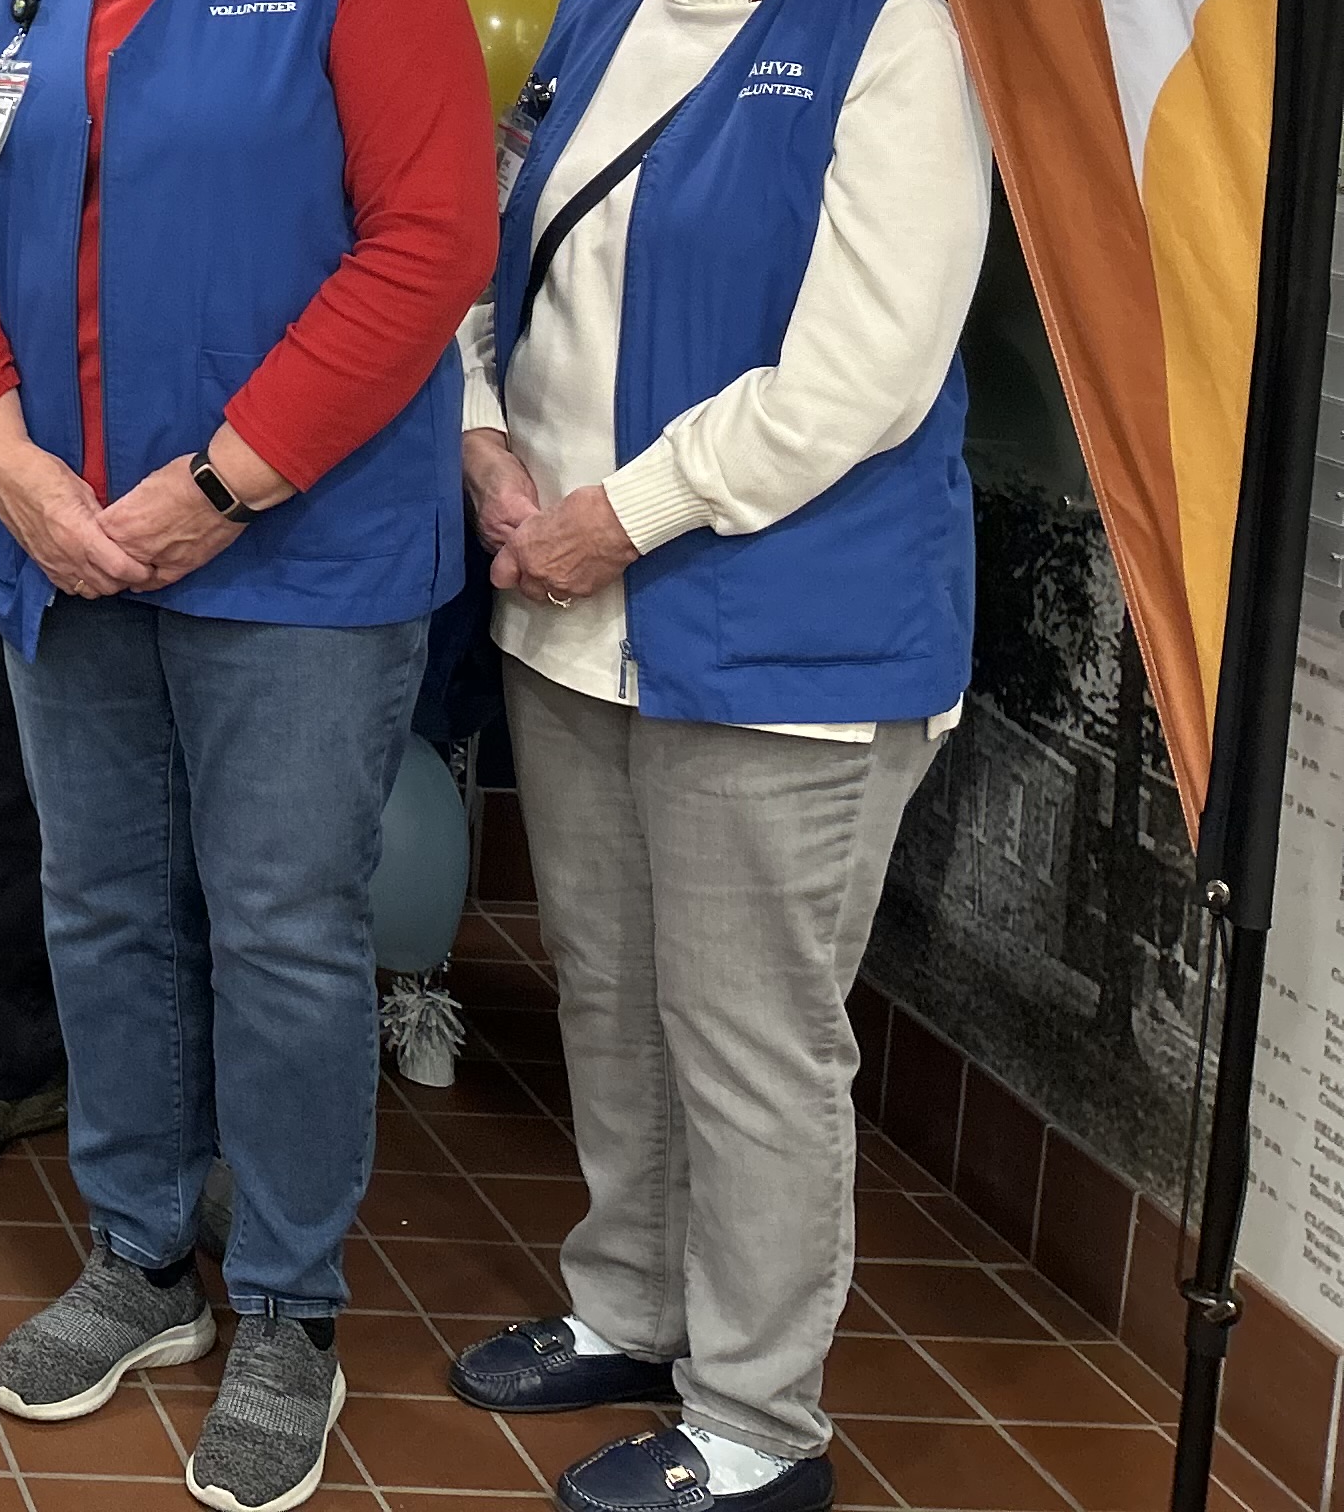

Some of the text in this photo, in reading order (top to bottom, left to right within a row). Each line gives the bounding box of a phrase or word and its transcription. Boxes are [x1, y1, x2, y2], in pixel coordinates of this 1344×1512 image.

[209, 1, 297, 16] VOLUNTEER
[747, 60, 803, 78] AHVB
[738, 82, 814, 101] OLUNTEER
